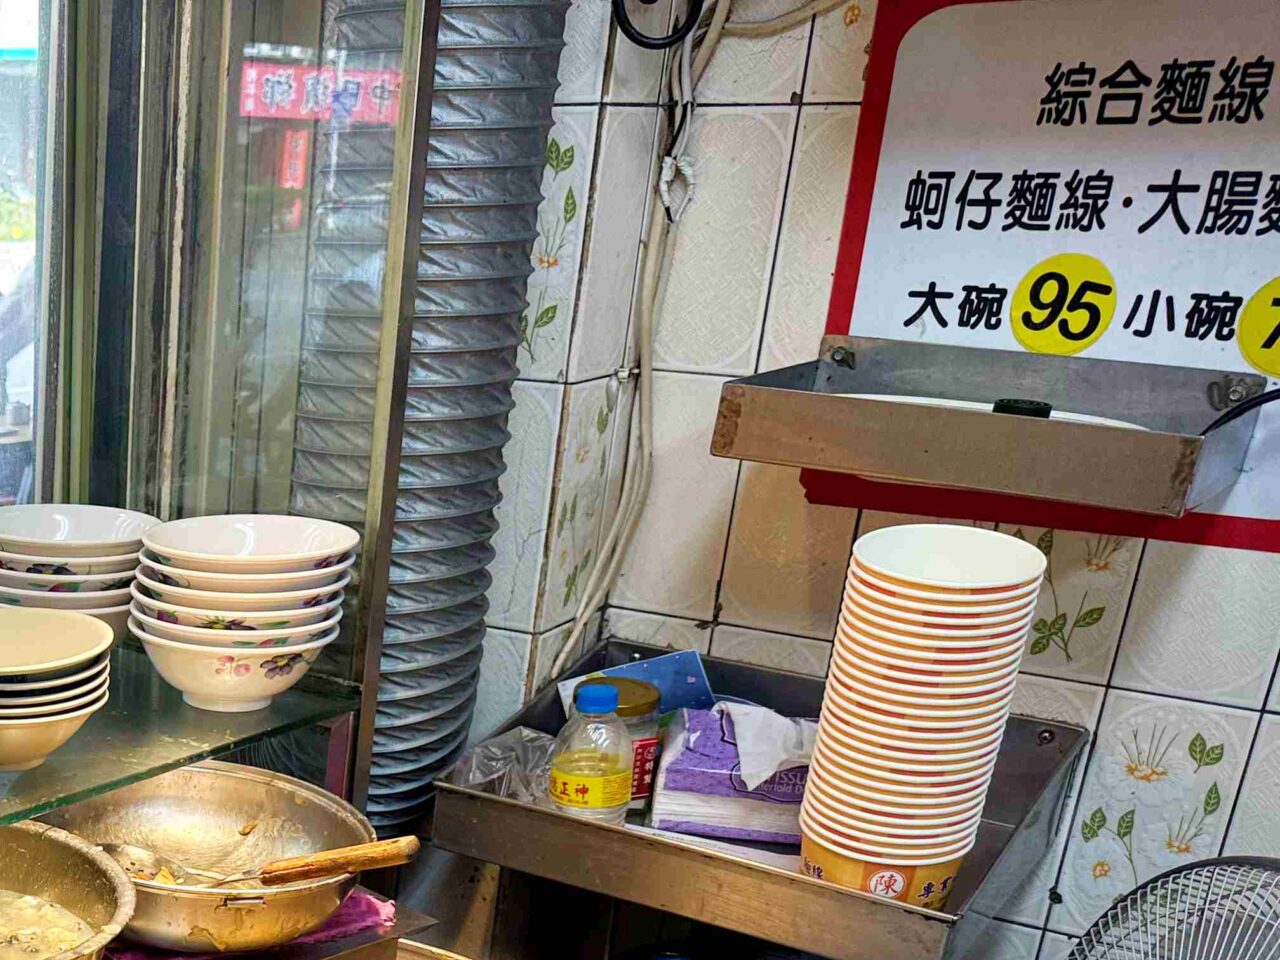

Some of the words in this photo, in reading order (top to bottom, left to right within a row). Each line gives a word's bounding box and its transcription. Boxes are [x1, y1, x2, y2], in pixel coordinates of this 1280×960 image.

[1036, 55, 1275, 127] 綜合麵線
[903, 281, 1008, 330] 大碗
[1021, 271, 1113, 342] 95
[1123, 289, 1243, 342] 小碗
[874, 874, 898, 895] 陳
